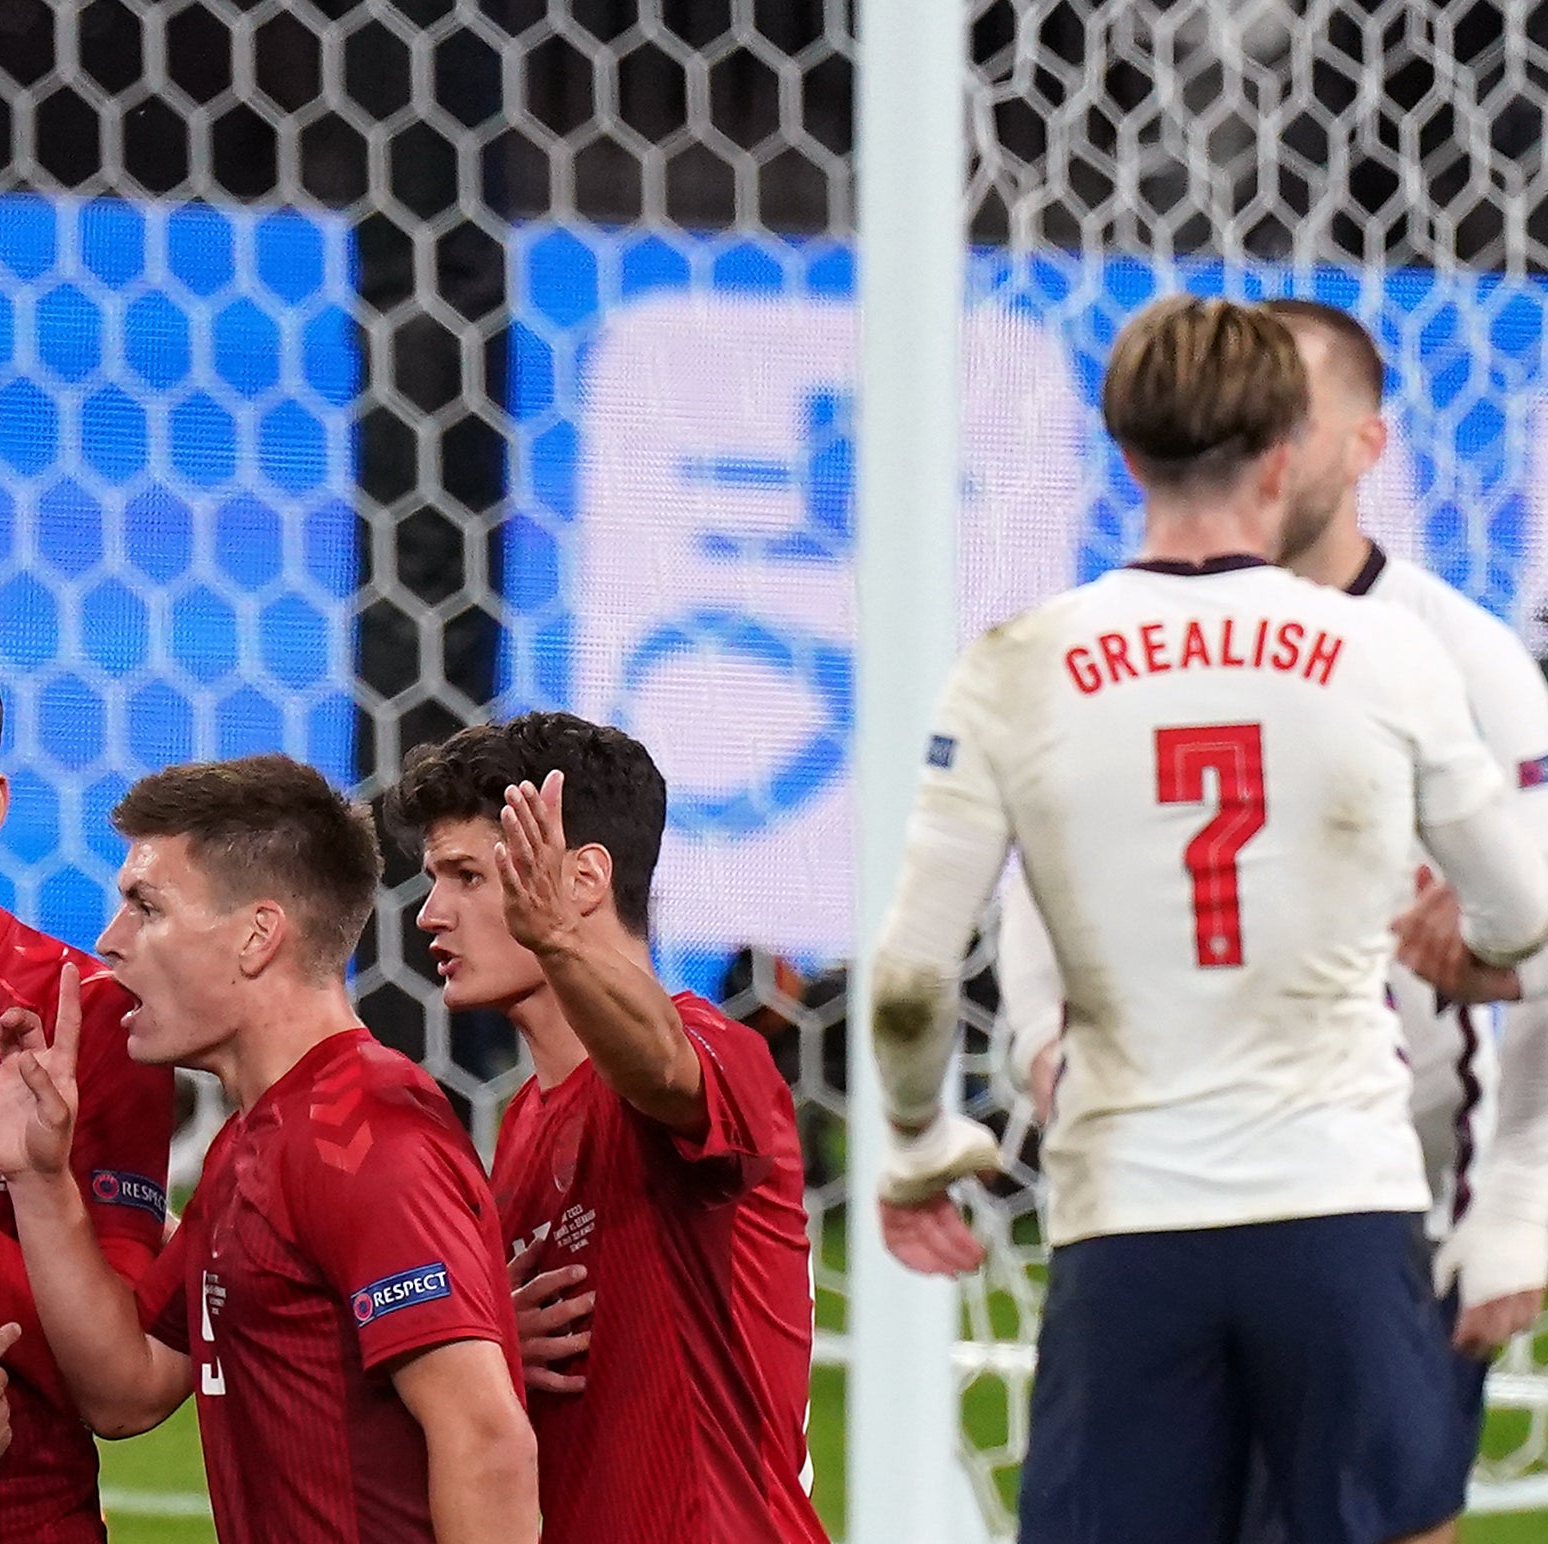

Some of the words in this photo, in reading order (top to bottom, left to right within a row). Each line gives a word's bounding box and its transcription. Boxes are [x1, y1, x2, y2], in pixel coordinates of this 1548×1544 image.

[1064, 619, 1347, 695] GREALISH
[1153, 722, 1267, 968] 7
[122, 1181, 167, 1213] RESPEC
[373, 1271, 447, 1307] RESPECT
